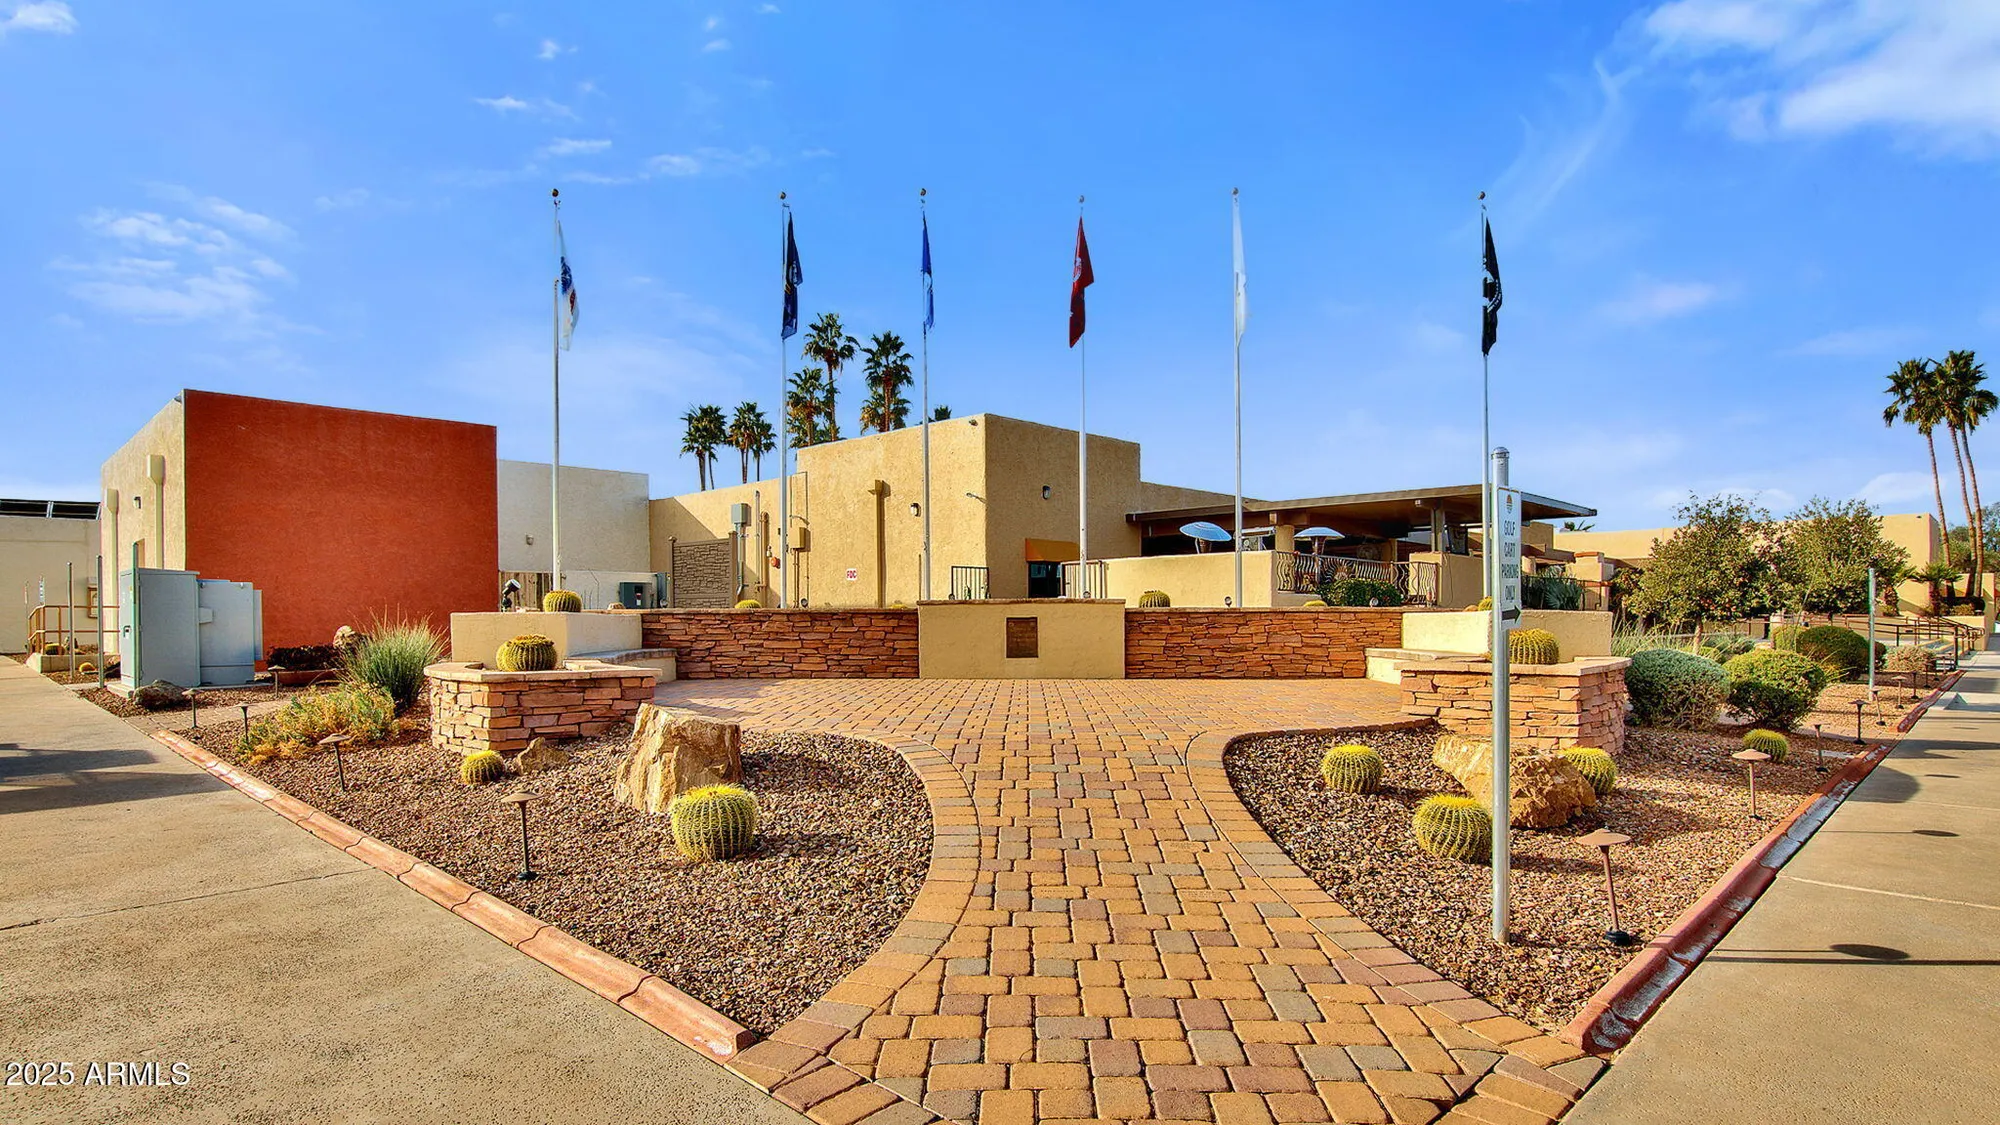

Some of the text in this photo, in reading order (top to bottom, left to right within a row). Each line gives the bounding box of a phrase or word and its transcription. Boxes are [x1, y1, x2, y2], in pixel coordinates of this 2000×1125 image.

[1504, 520, 1515, 535] GOLF
[1504, 542, 1515, 557] CART
[847, 570, 857, 579] FDC
[1501, 563, 1519, 579] PARKING
